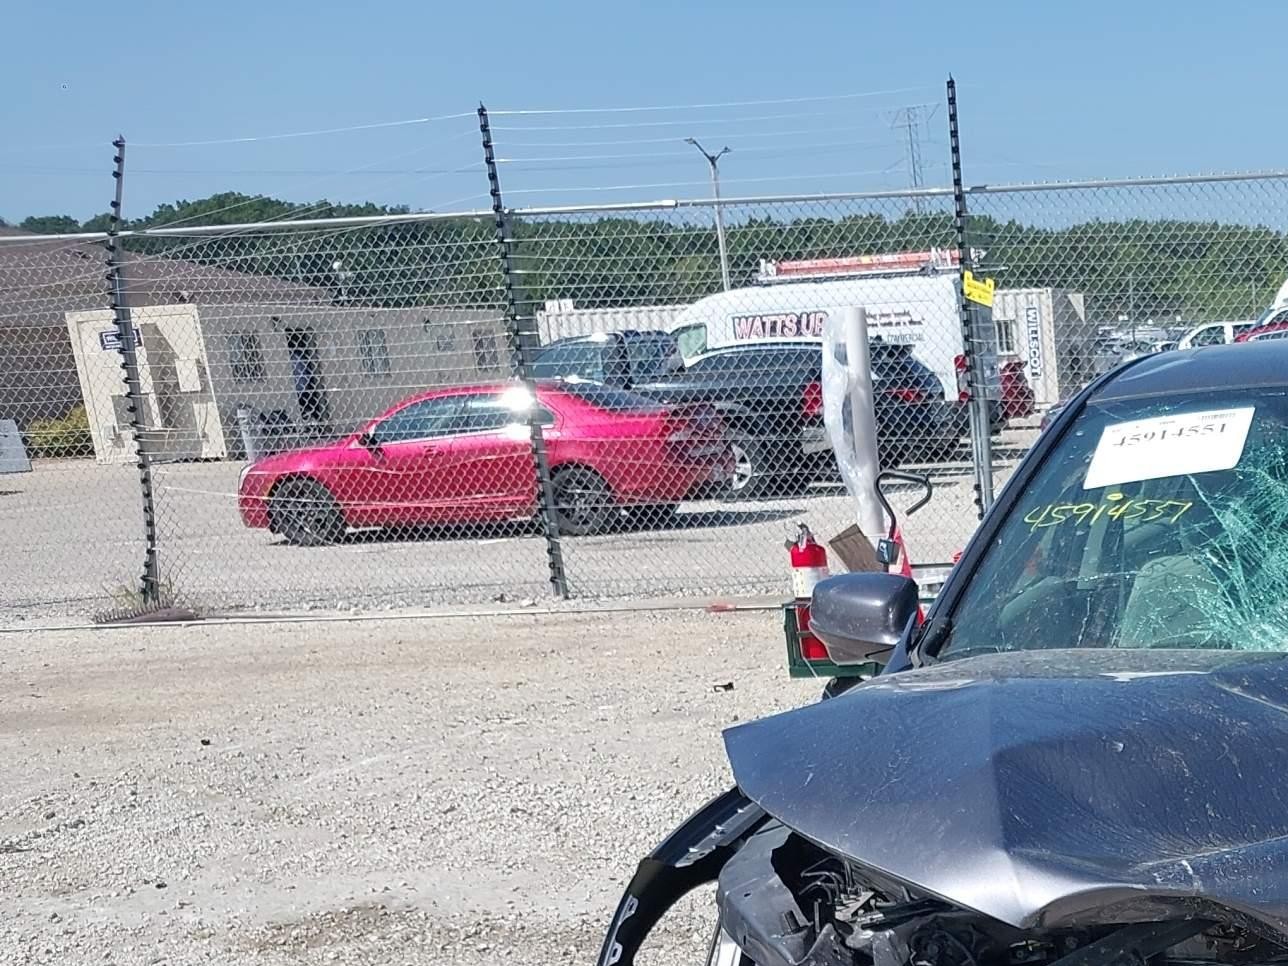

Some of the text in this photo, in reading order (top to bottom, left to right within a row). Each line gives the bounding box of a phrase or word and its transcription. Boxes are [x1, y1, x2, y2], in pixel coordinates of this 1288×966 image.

[732, 312, 799, 341] WATTS
[1025, 307, 1042, 378] WILLSCOT
[1112, 422, 1227, 448] 45914551
